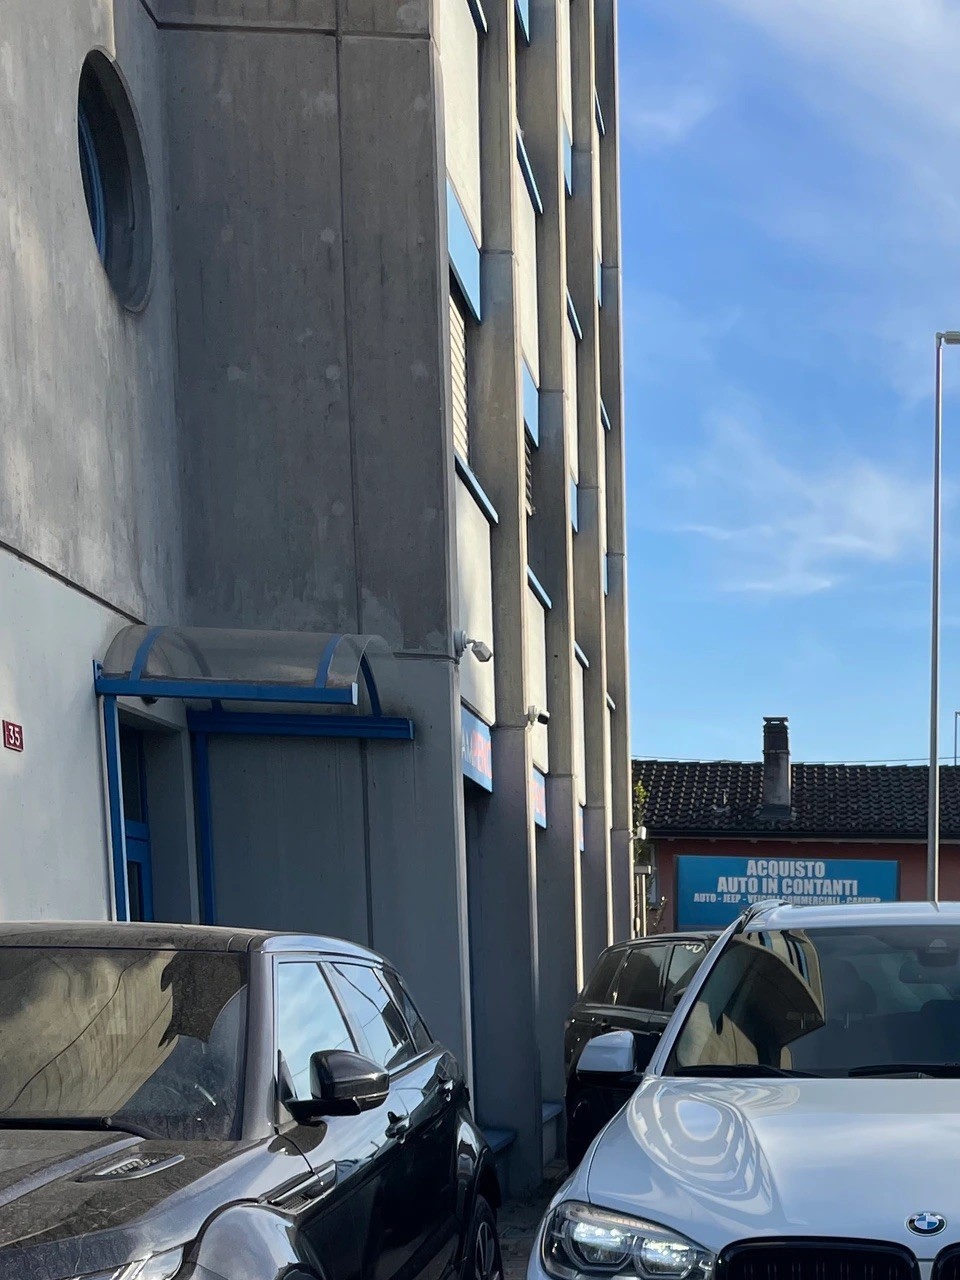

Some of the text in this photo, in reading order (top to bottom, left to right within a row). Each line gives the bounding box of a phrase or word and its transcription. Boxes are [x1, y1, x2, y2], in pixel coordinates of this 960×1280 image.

[8, 725, 21, 746] 35
[746, 860, 826, 877] ACQUISTO
[717, 876, 858, 896] AUTO IN CONTANTI
[693, 893, 717, 903] AUTO
[722, 893, 742, 904] JEEP
